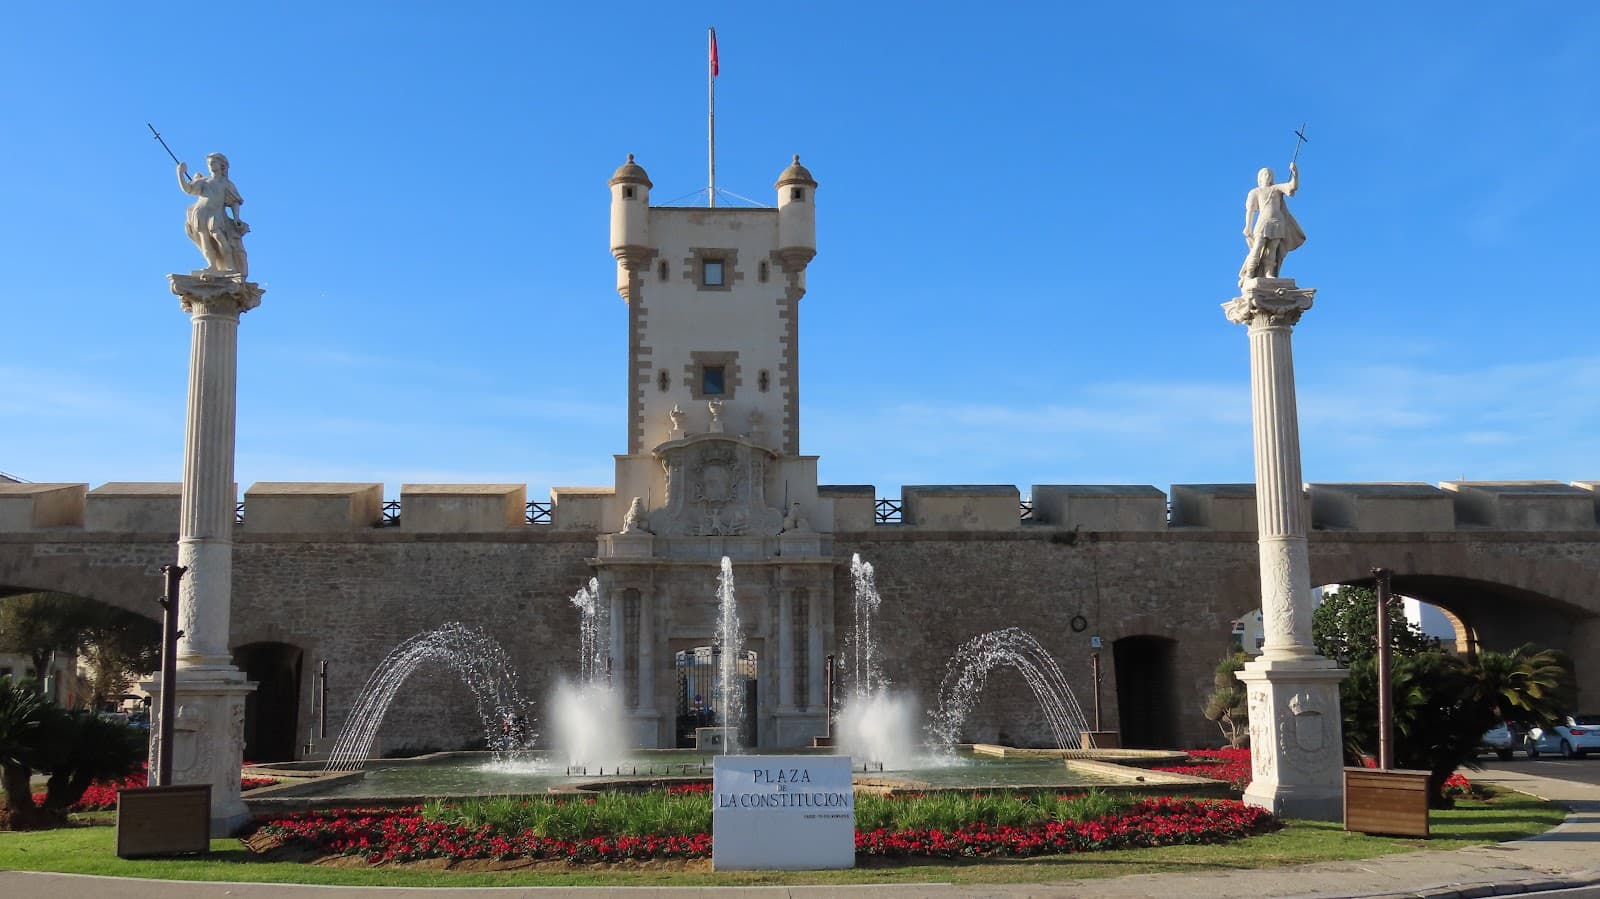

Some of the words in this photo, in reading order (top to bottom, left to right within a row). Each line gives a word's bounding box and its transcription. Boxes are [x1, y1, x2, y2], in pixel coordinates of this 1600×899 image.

[754, 769, 811, 783] PLAZA
[777, 784, 787, 792] DE
[720, 793, 737, 808] LA
[740, 793, 848, 808] CONSTITUCION
